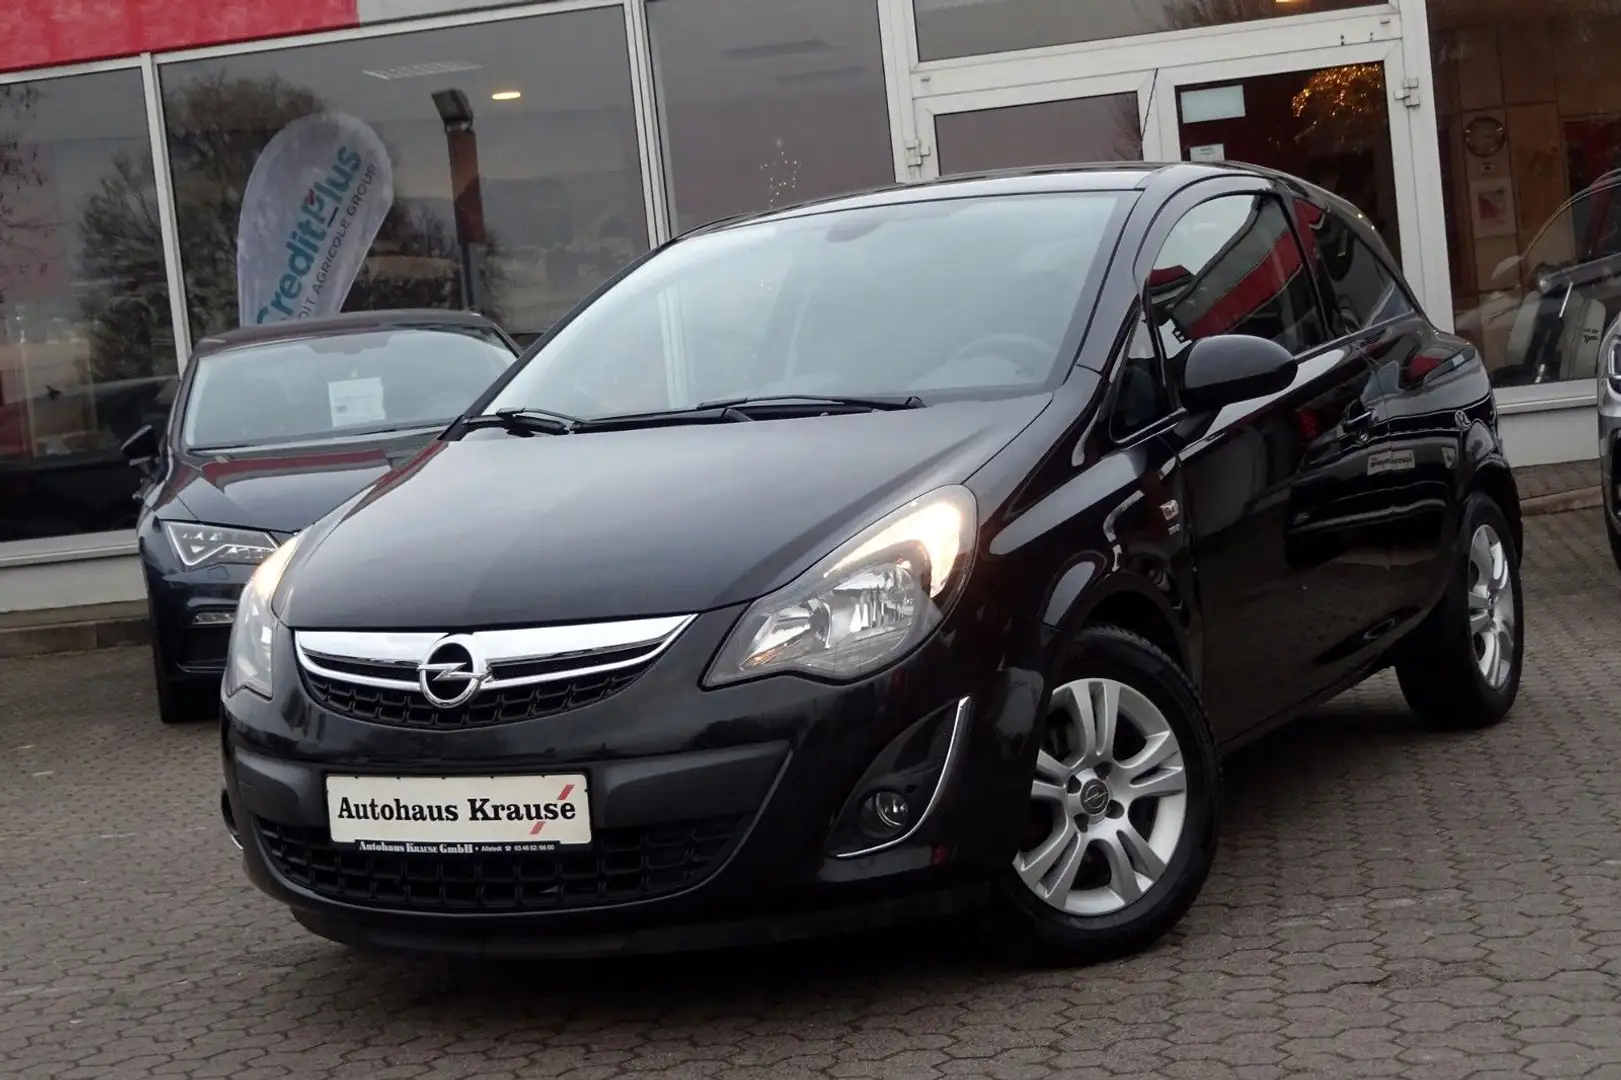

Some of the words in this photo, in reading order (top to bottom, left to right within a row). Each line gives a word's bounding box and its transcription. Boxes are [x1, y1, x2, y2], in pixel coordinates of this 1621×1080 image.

[314, 217, 350, 296] AGRICOLE
[346, 163, 377, 217] GROUP
[338, 796, 459, 821] Autohaus
[467, 798, 576, 821] Krause
[359, 841, 405, 852] Autohaus
[439, 843, 474, 853] GmbH
